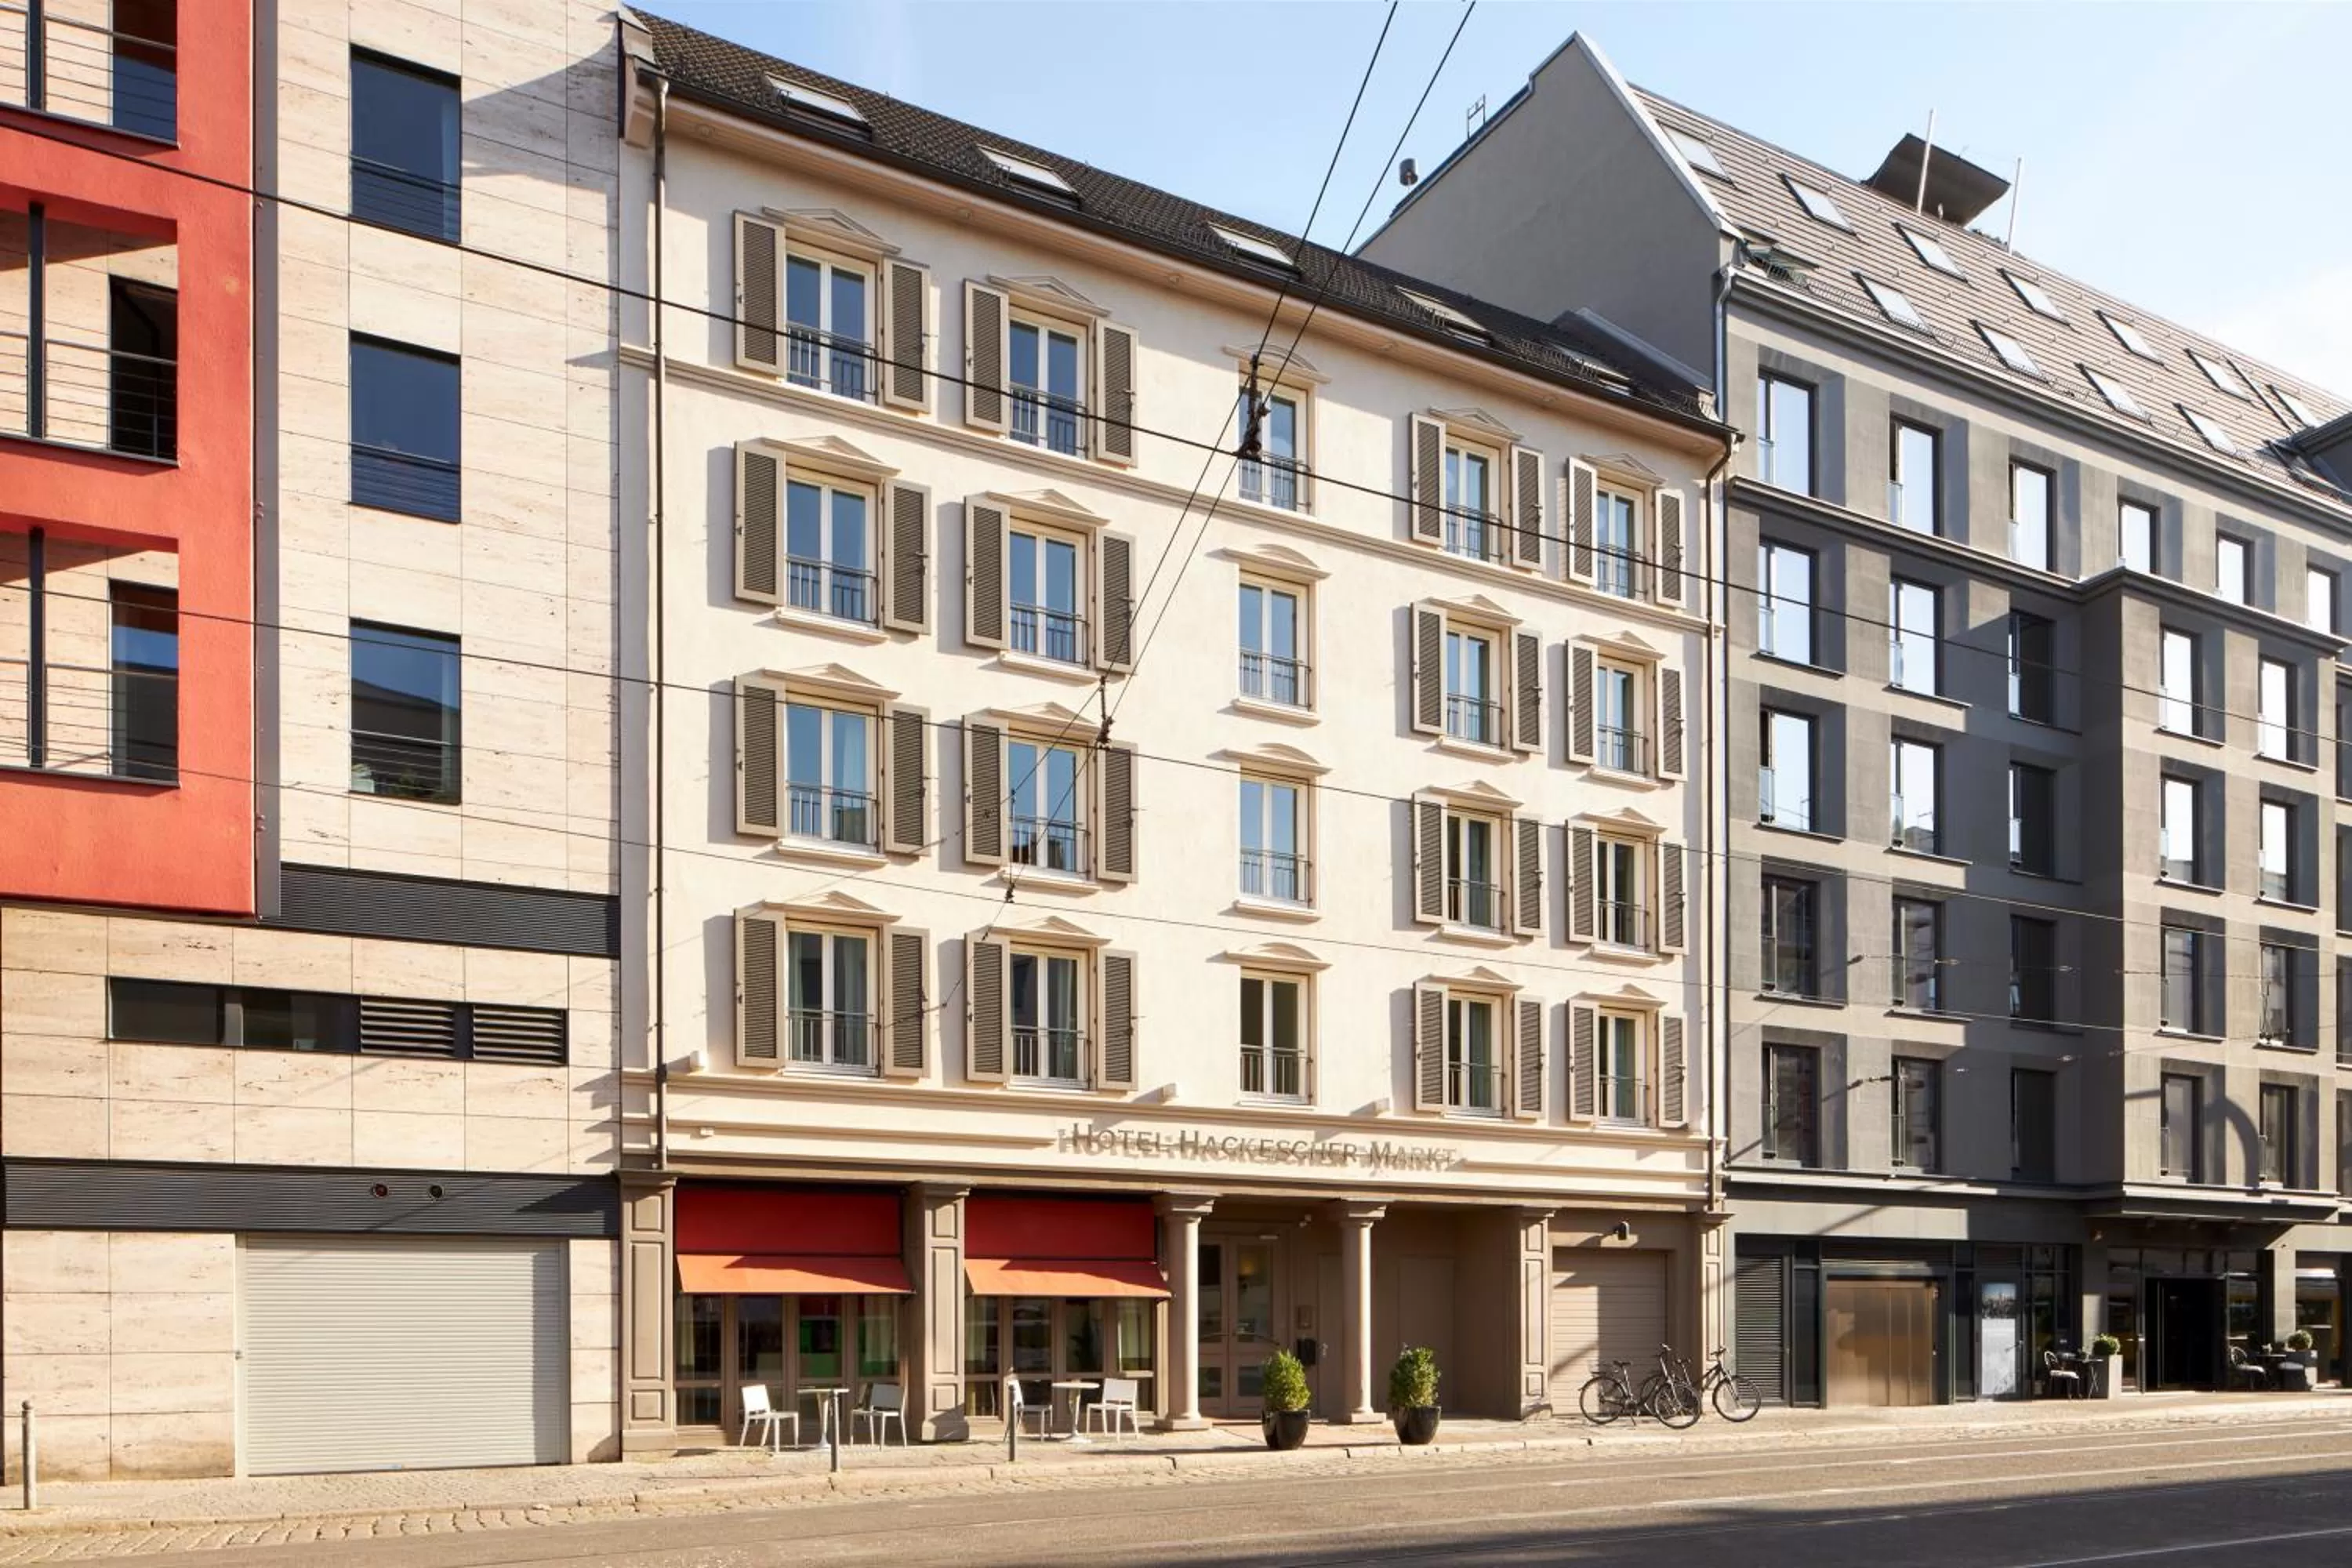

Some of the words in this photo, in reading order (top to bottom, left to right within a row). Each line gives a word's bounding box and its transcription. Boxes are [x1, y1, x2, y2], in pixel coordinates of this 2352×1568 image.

[1073, 1123, 1170, 1152] HOTEL
[1180, 1130, 1358, 1162] HACKESCHER
[1370, 1141, 1457, 1164] MARKT
